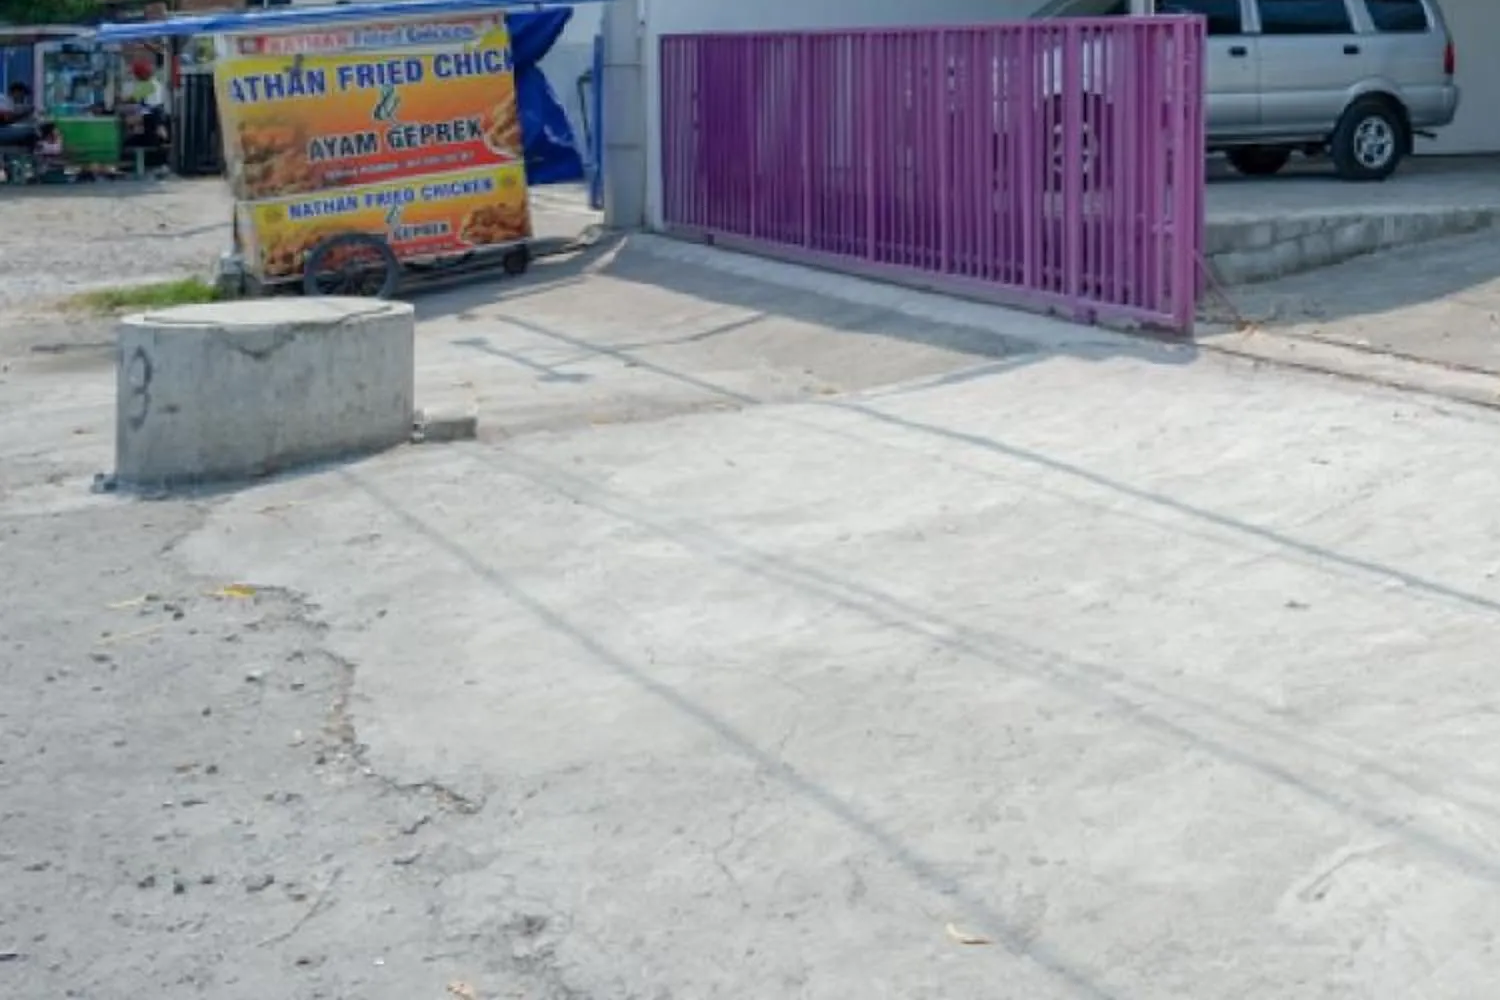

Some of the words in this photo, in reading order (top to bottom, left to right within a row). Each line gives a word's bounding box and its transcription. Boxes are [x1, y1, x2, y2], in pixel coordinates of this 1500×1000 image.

[337, 58, 423, 90] FRIED
[308, 132, 377, 159] AYAM
[387, 119, 482, 149] GEPREK
[289, 195, 357, 219] NATHAN
[364, 187, 415, 207] FRIED
[421, 178, 493, 200] CHICKEN
